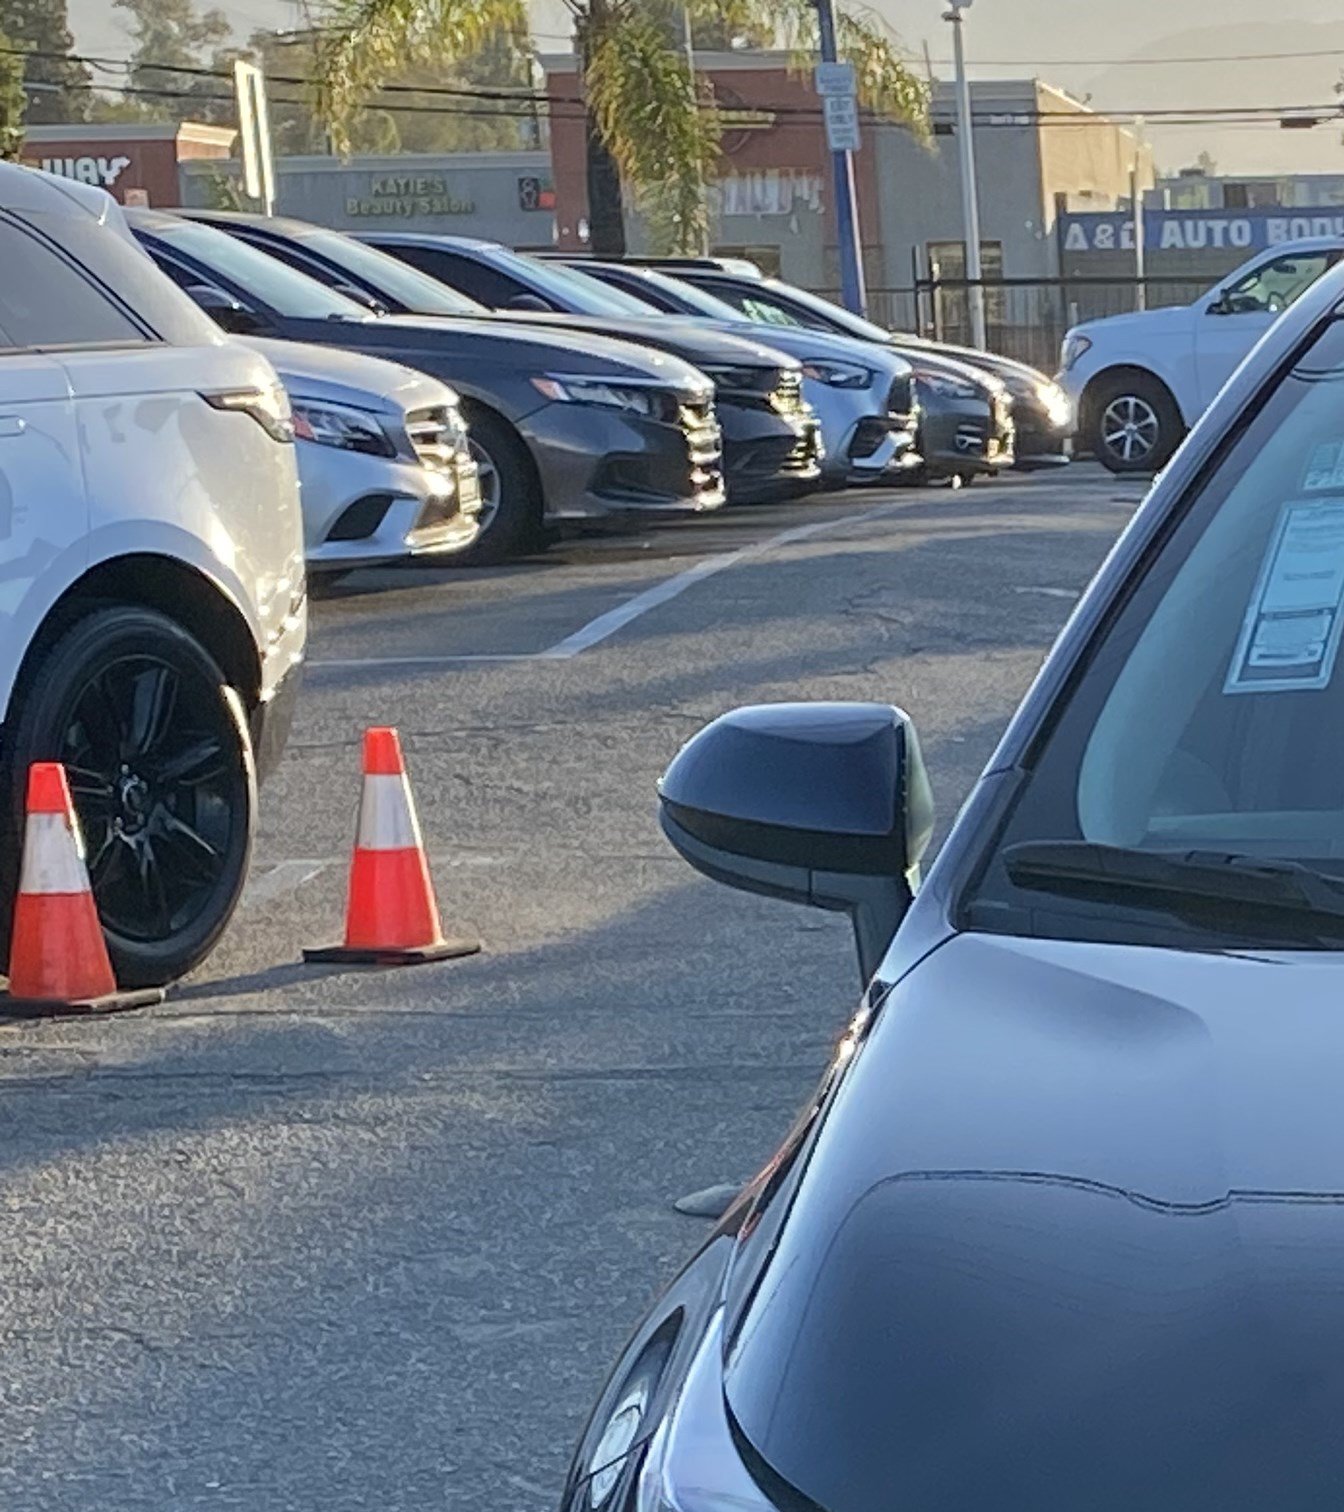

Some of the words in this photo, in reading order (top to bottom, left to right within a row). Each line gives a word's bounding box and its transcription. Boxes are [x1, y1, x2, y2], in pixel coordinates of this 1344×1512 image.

[346, 197, 413, 216] Beauty
[416, 195, 474, 214] Salon
[1159, 219, 1251, 249] AUTO
